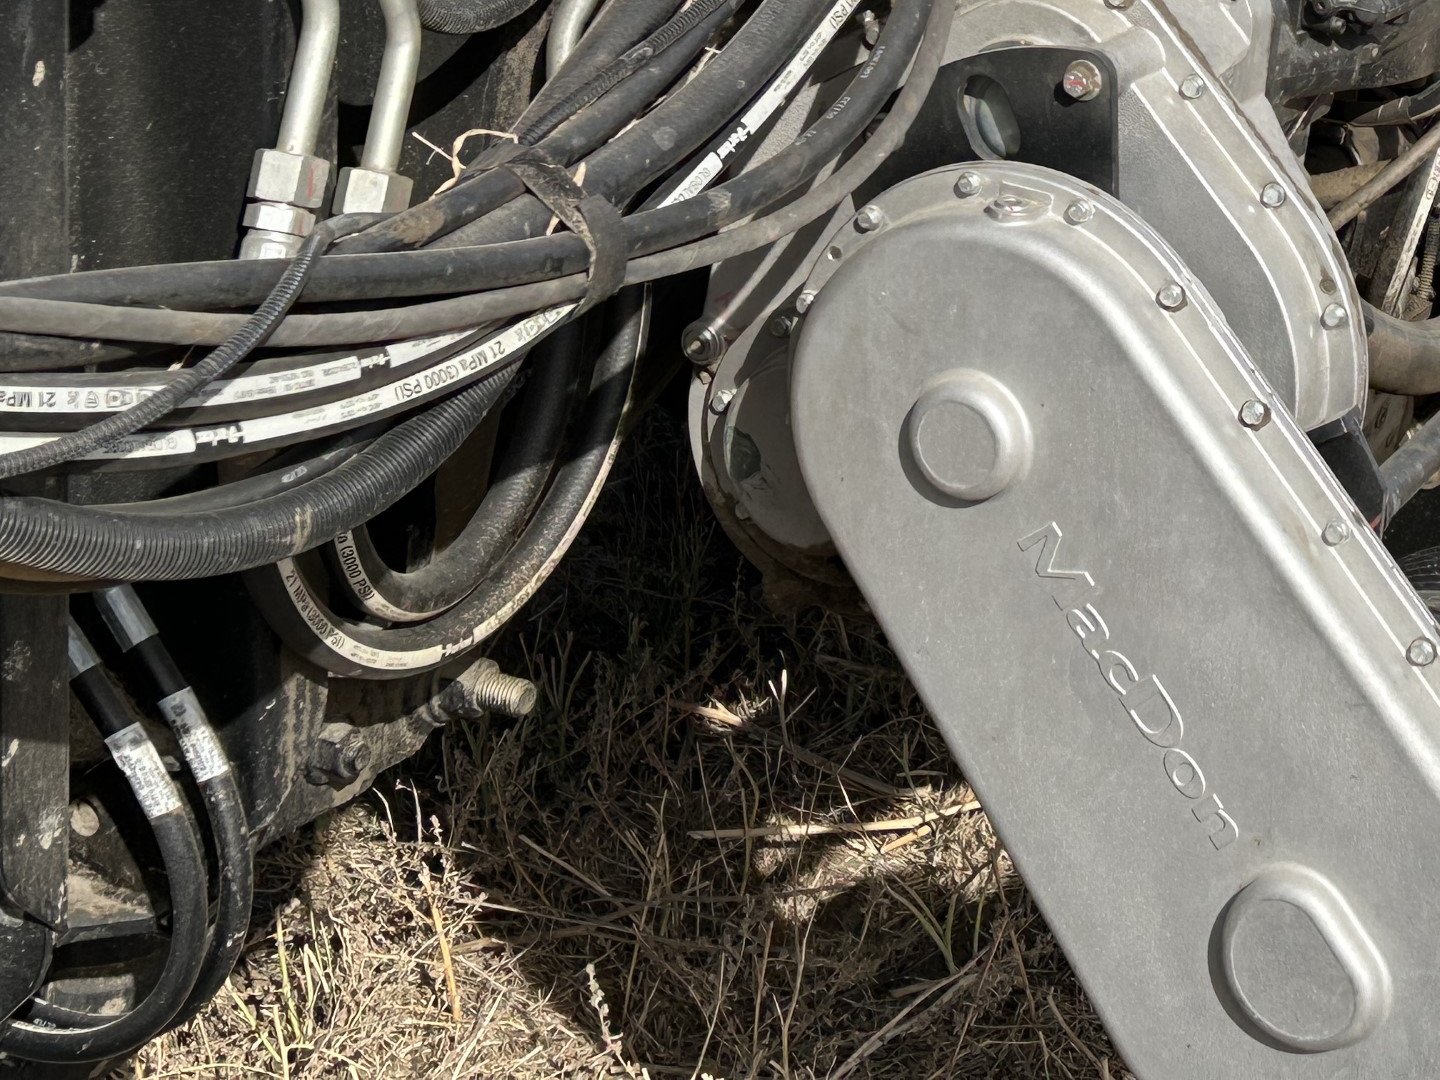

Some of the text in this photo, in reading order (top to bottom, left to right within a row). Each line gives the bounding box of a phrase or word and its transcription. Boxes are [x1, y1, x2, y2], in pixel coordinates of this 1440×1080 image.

[394, 341, 506, 401] 21 MPa (3000 PSI)
[39, 391, 56, 408] 21
[341, 545, 361, 579] (3000
[1017, 521, 1240, 851] MacDon
